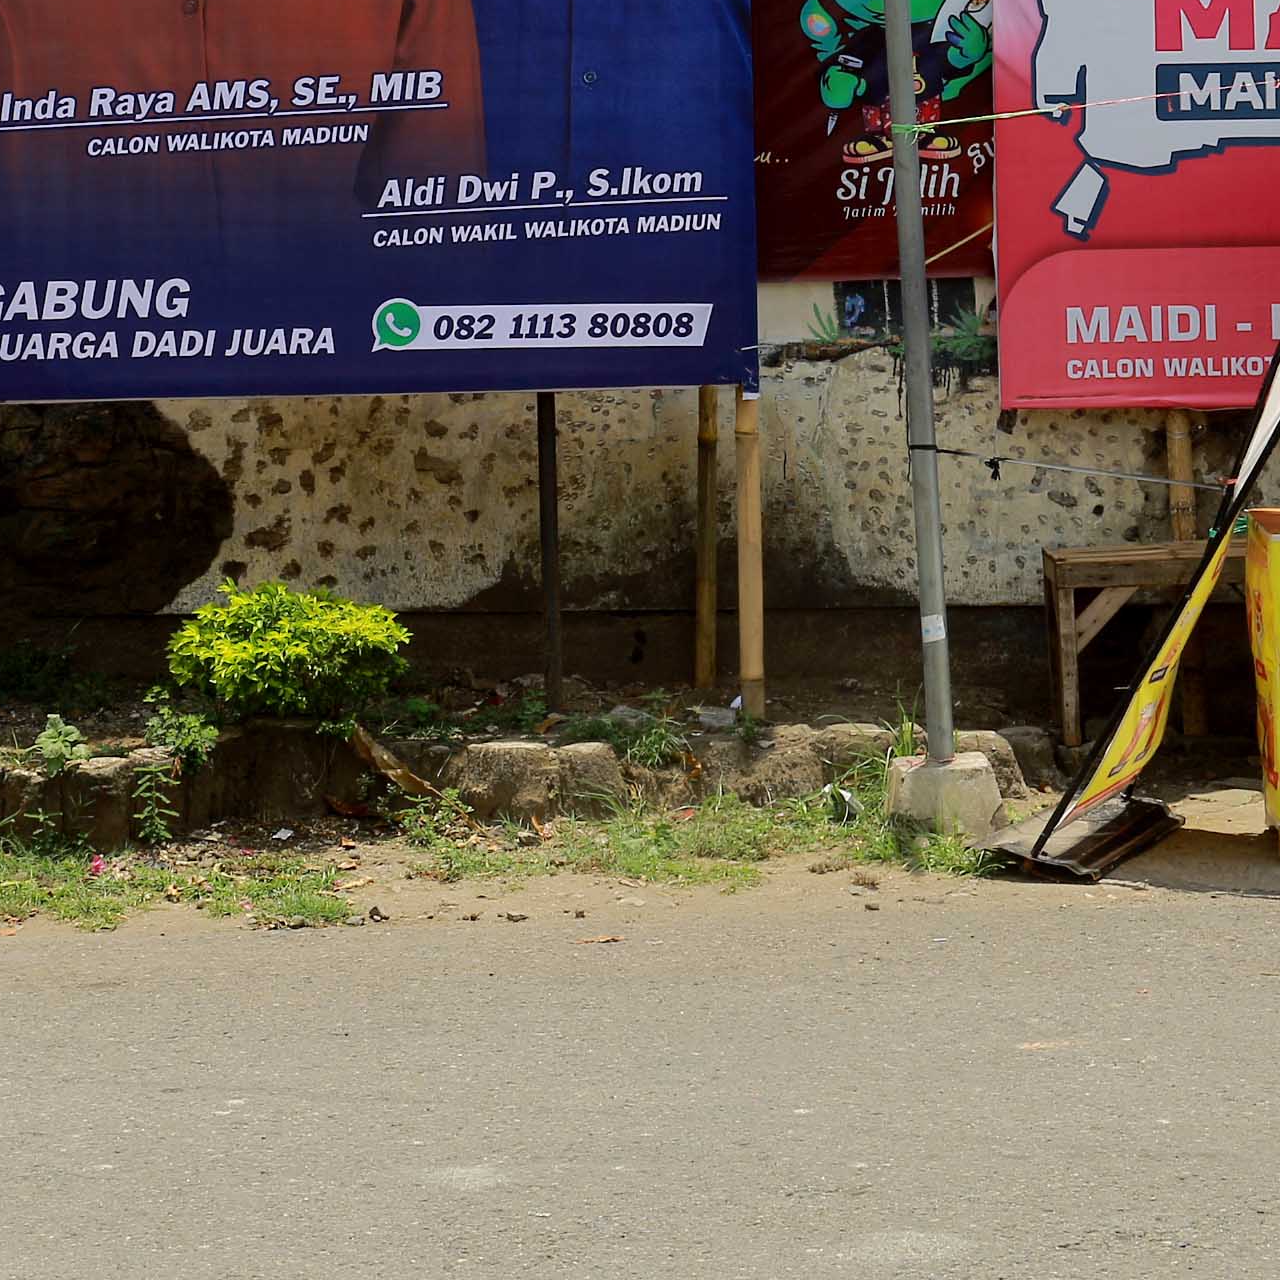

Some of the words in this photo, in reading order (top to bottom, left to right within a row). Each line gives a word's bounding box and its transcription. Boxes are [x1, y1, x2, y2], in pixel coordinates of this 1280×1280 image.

[0, 92, 76, 122] Inda
[88, 86, 175, 121] Raya
[184, 79, 280, 115] AMS,
[369, 70, 443, 103] MIB
[87, 134, 160, 158] CALON
[166, 129, 275, 153] WALIKOTA
[280, 124, 370, 147] MADIUN
[376, 176, 446, 209] Aldi
[456, 173, 519, 205] Dwi
[836, 166, 872, 201] Si
[372, 226, 444, 248] CALON
[450, 222, 518, 244] WAKIL
[523, 217, 630, 240] WALIKOTA
[635, 213, 722, 235] MADIUN
[431, 314, 496, 340] 082
[508, 312, 577, 339] 1113
[586, 311, 695, 338] 80808
[1064, 303, 1217, 344] MAIDI
[130, 329, 217, 358] DADI
[224, 326, 337, 357] JUARA
[1066, 357, 1154, 380] CALON
